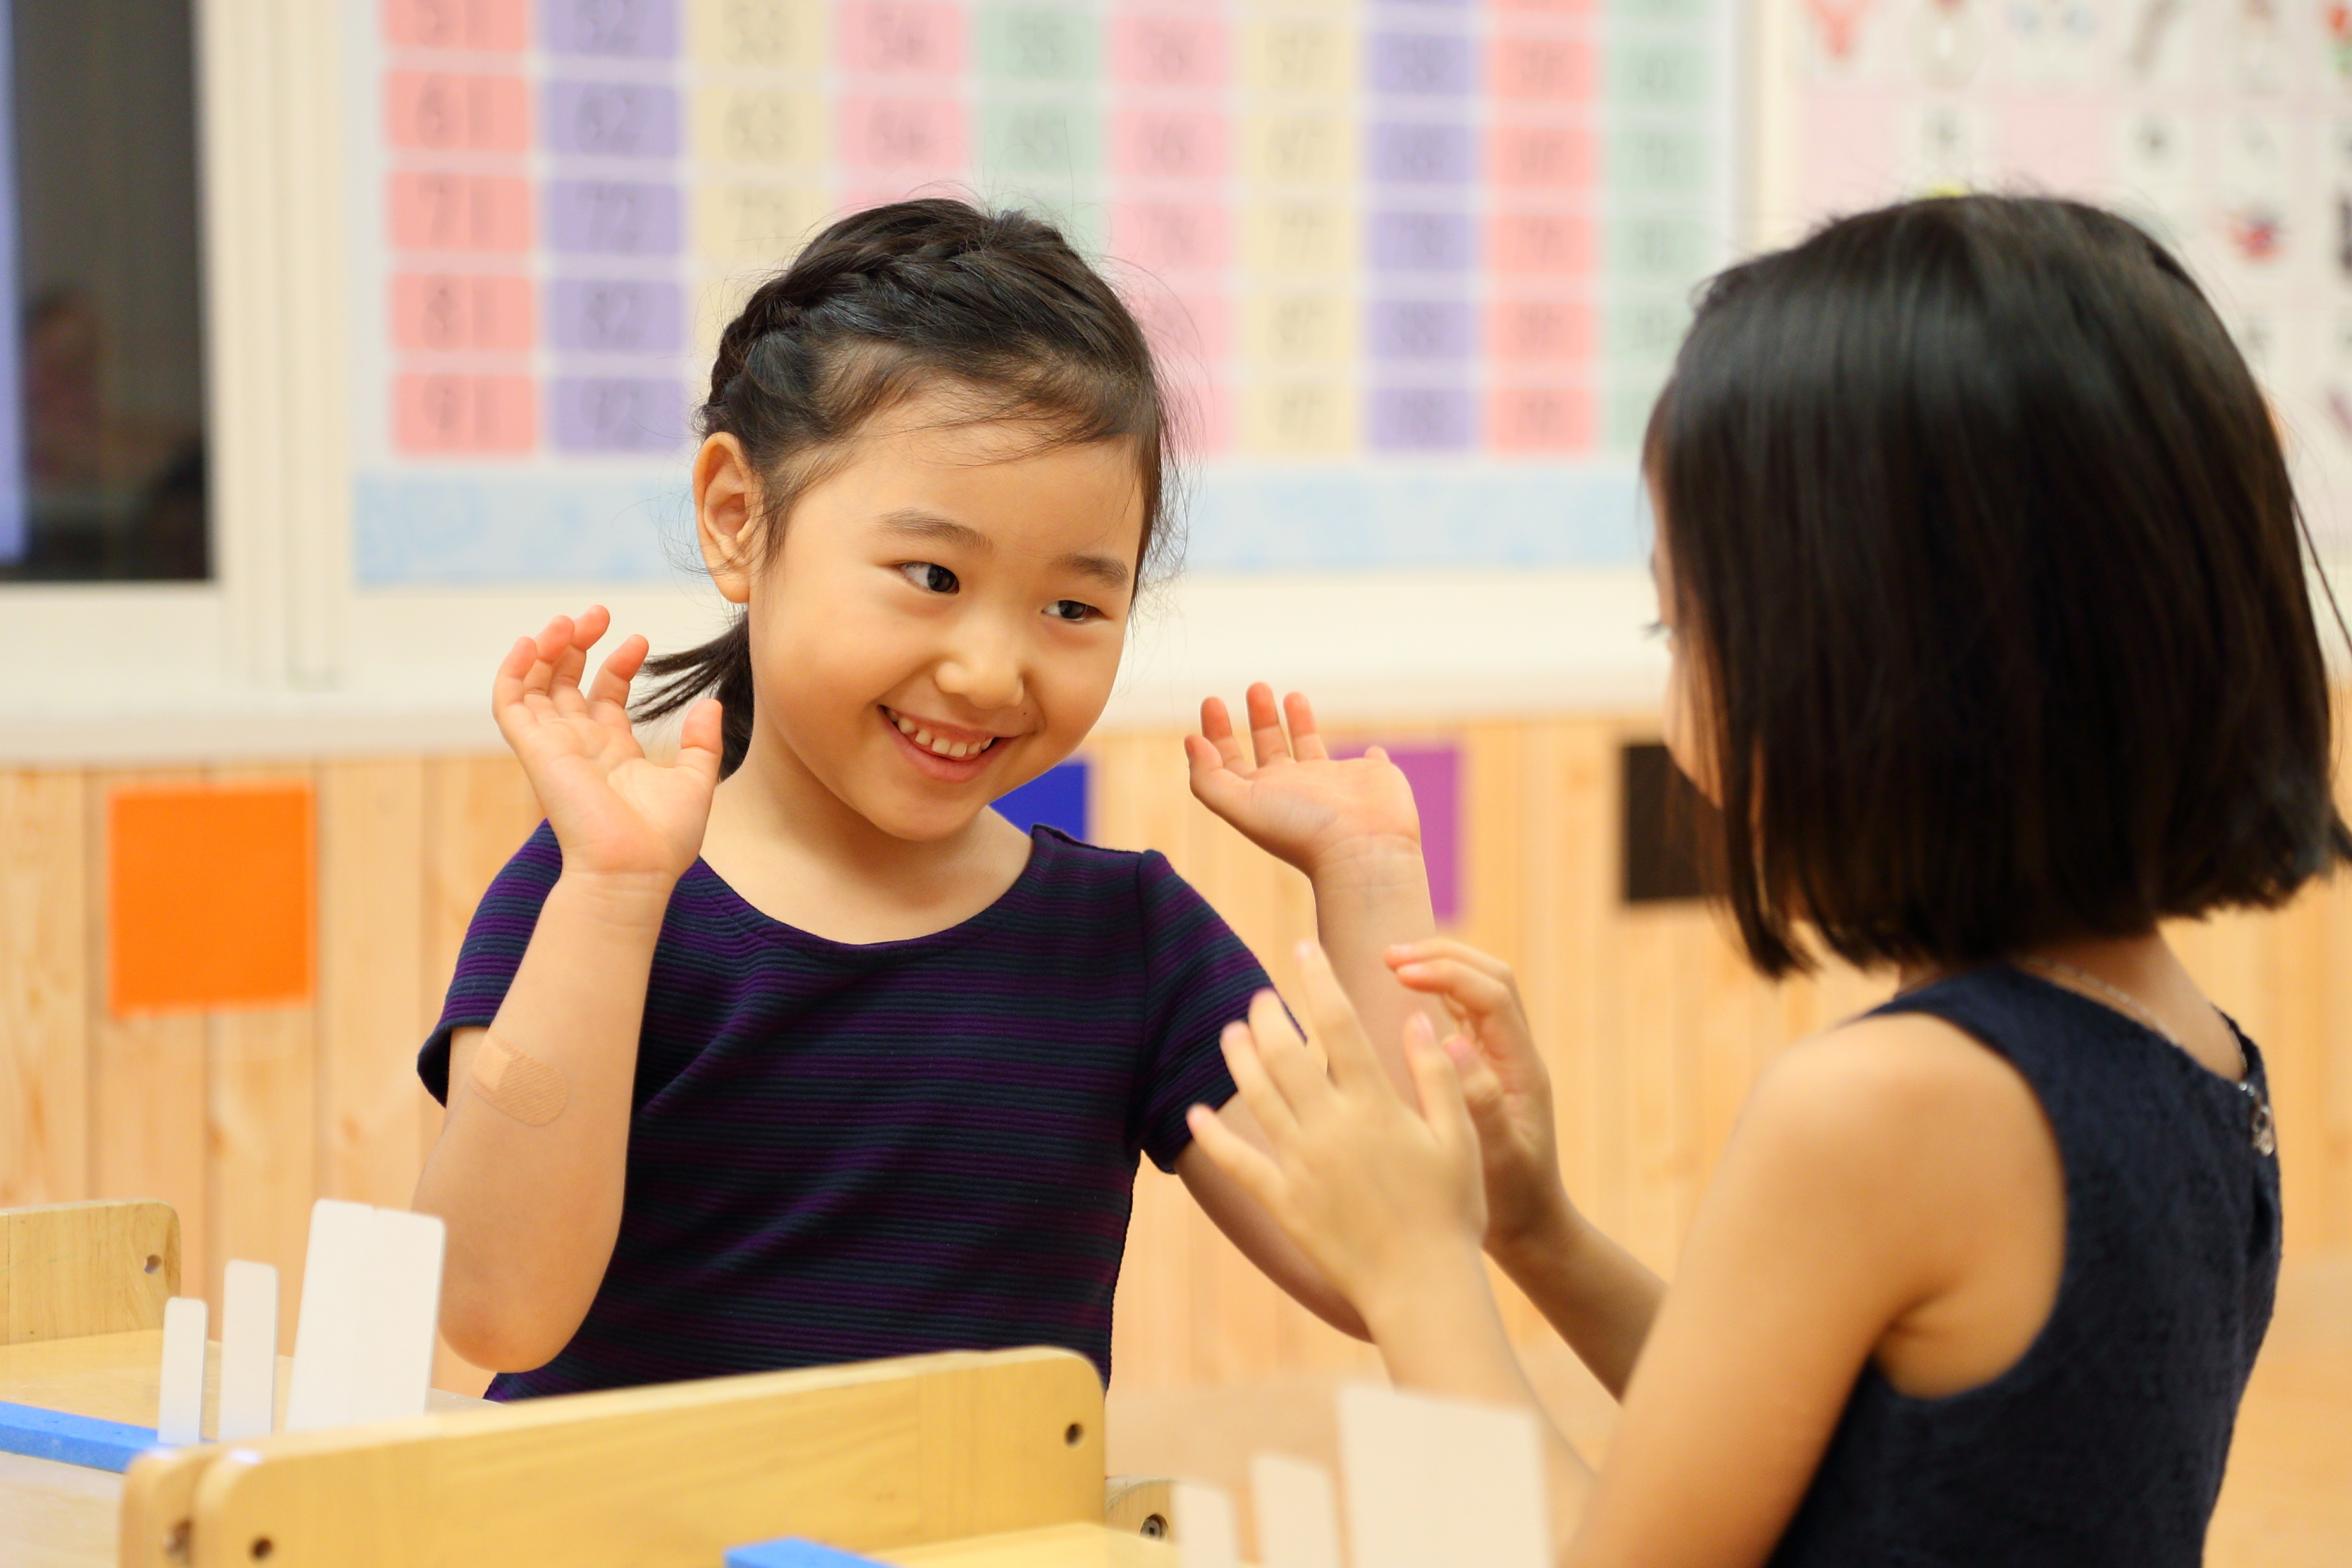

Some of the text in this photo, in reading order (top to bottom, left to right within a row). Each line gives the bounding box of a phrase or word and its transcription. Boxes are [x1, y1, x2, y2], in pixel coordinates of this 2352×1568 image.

[415, 73, 494, 150] 61
[573, 84, 645, 158] 62
[721, 89, 797, 166] 63
[417, 174, 496, 251] 71
[577, 182, 648, 256] 72
[421, 275, 500, 351] 81
[578, 281, 649, 352] 82
[421, 376, 501, 452] 91
[578, 378, 650, 449] 92
